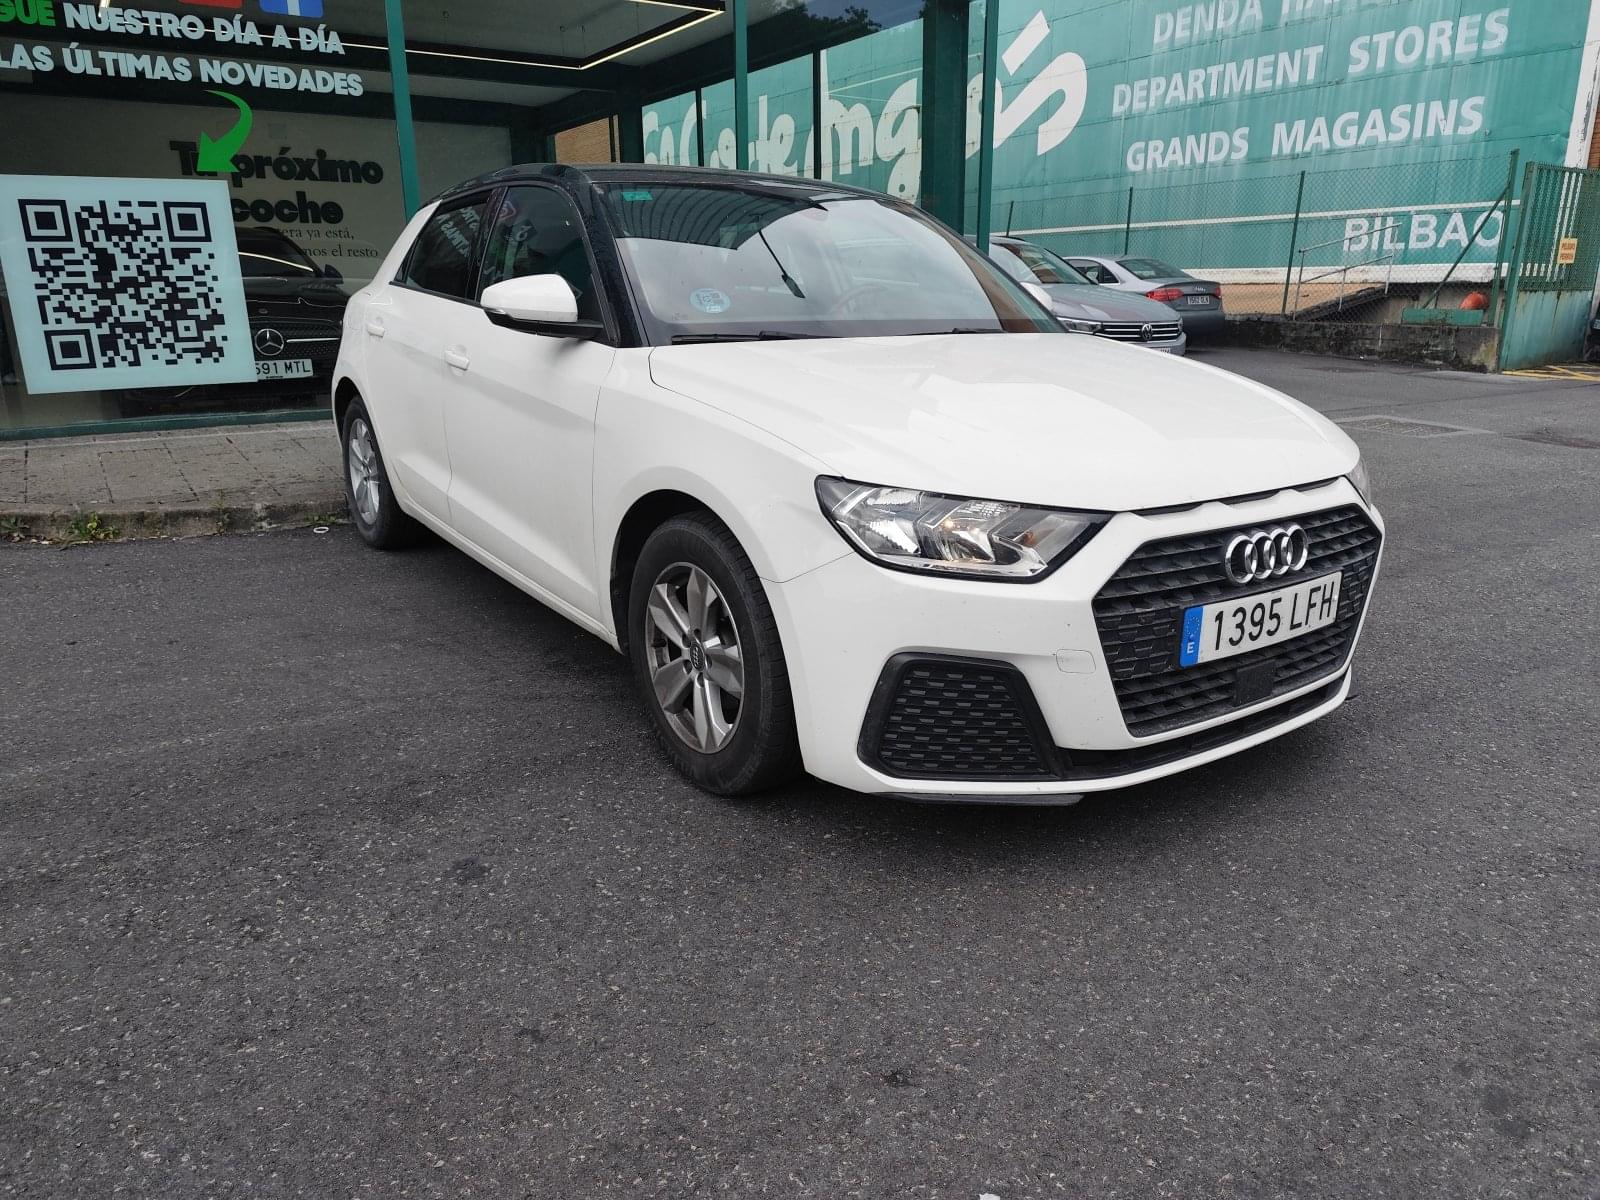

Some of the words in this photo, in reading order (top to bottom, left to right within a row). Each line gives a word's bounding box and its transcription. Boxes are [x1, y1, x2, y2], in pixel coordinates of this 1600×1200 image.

[63, 2, 205, 40] NUESTRO
[213, 14, 263, 47] DÍA
[271, 25, 292, 49] A
[299, 24, 346, 55] DÍA
[1153, 0, 1264, 45] DENDA
[62, 42, 193, 82] ÚLTIMAS
[199, 59, 365, 97] NOVEDADES
[1111, 45, 1325, 117] DEPARTMENT
[1348, 10, 1510, 75] STORES
[1126, 126, 1250, 173] GRANDS
[1271, 96, 1487, 156] MAGASINS
[231, 147, 384, 188] próximo
[231, 191, 345, 225] coche
[347, 247, 379, 258] resto
[1342, 210, 1506, 253] BILBAO
[284, 361, 311, 374] MTL
[1214, 597, 1282, 651] 1395
[1289, 581, 1335, 630] LFH
